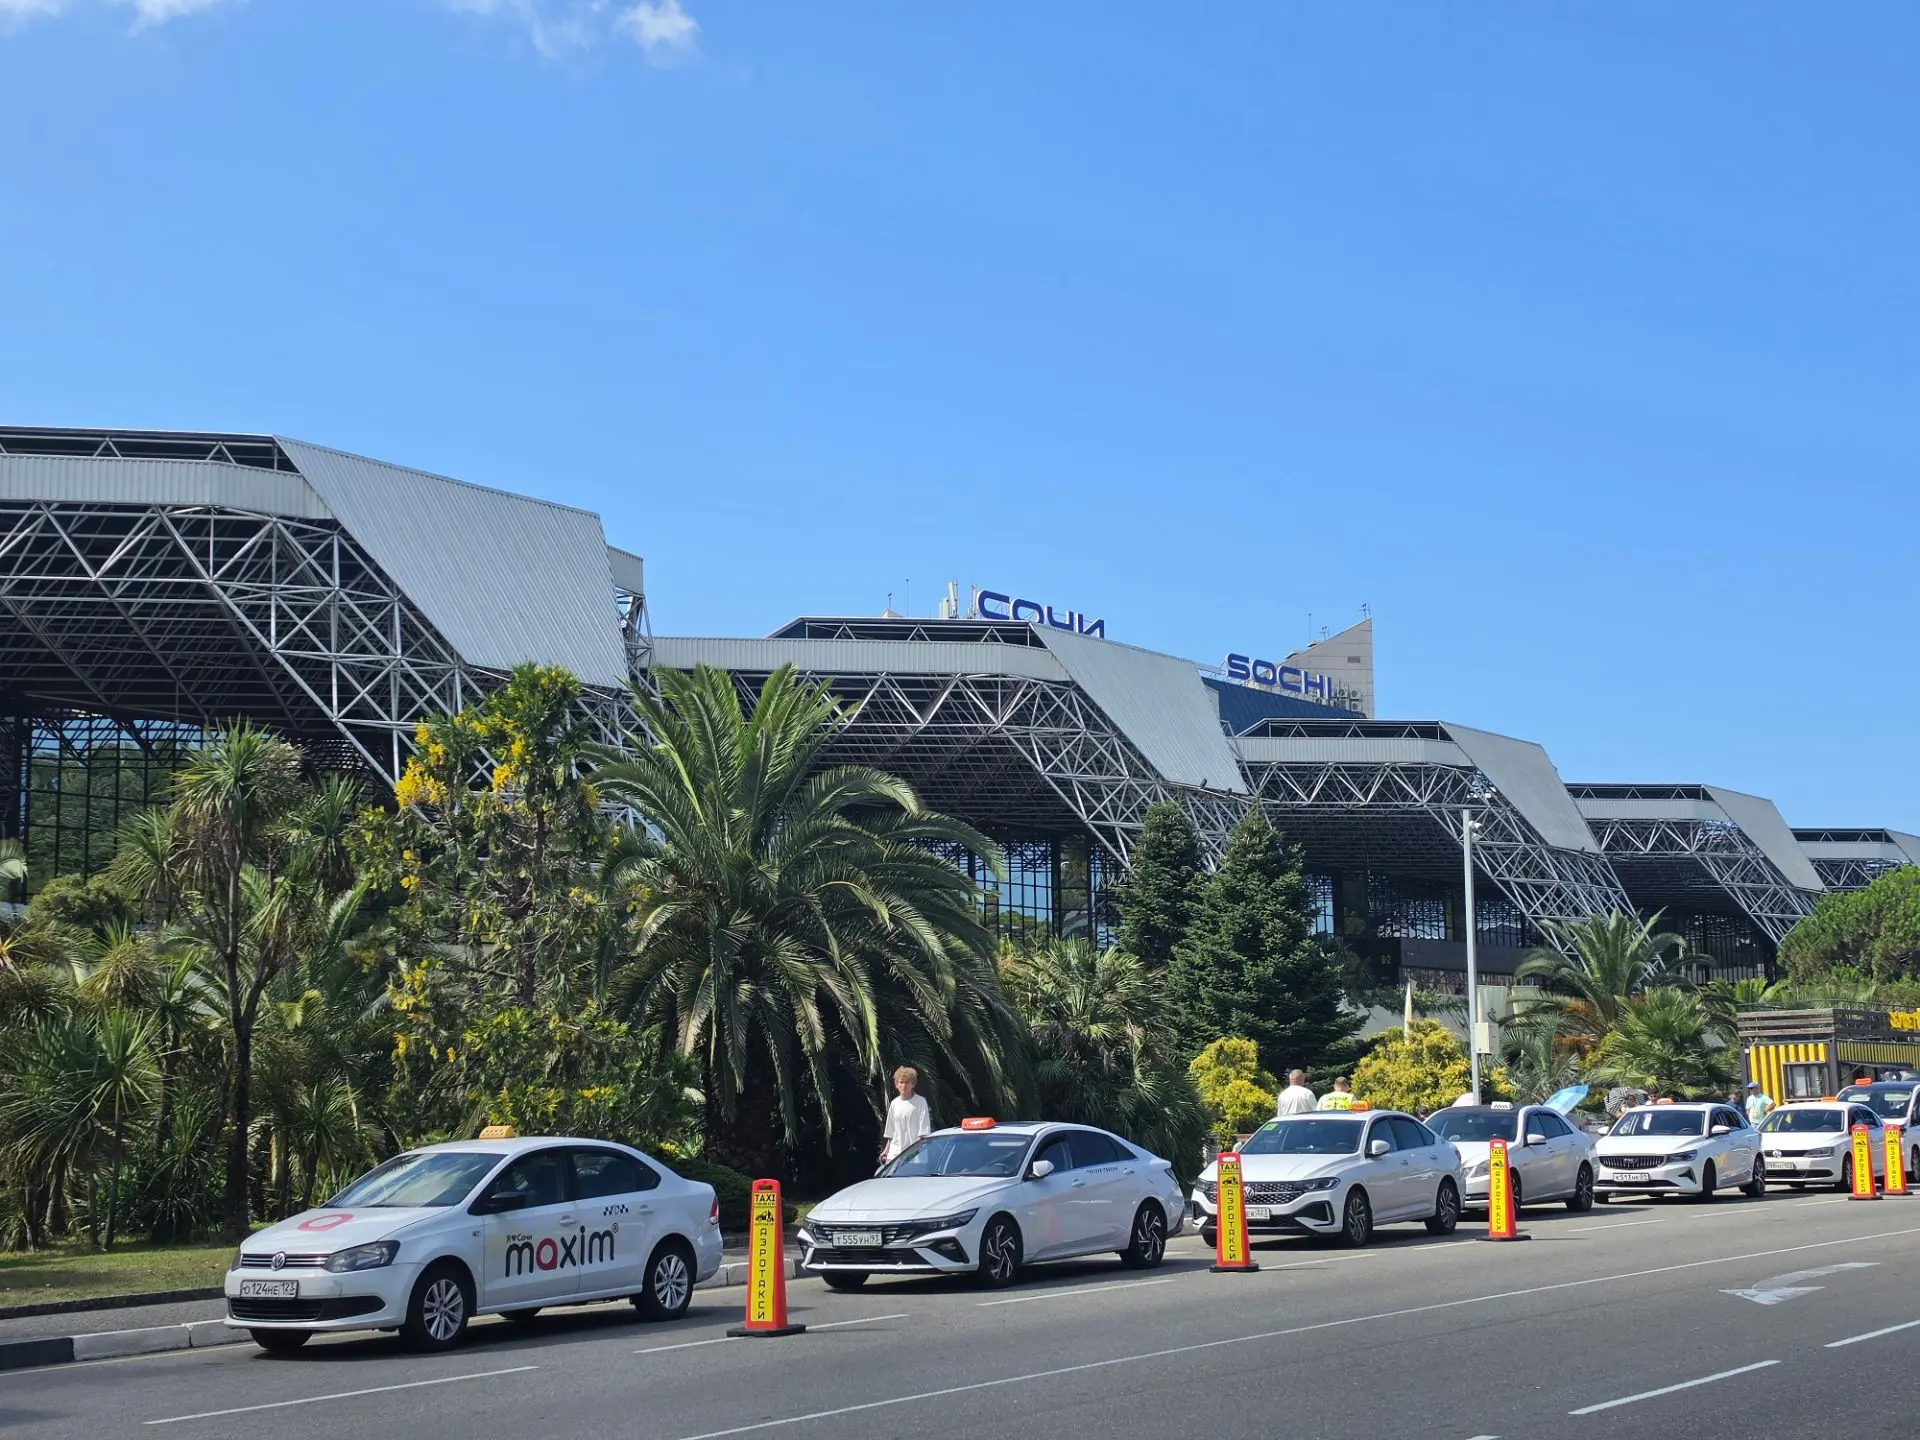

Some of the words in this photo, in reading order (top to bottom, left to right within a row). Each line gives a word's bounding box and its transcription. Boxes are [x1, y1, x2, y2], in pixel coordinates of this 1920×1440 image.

[977, 590, 1104, 639] СОЧИ
[1226, 653, 1332, 704] SOCHI
[755, 1194, 775, 1202] TAXI
[1227, 1189, 1236, 1259] АЭРОТАКСИ
[757, 1228, 767, 1320] АЭРОТАКСИ
